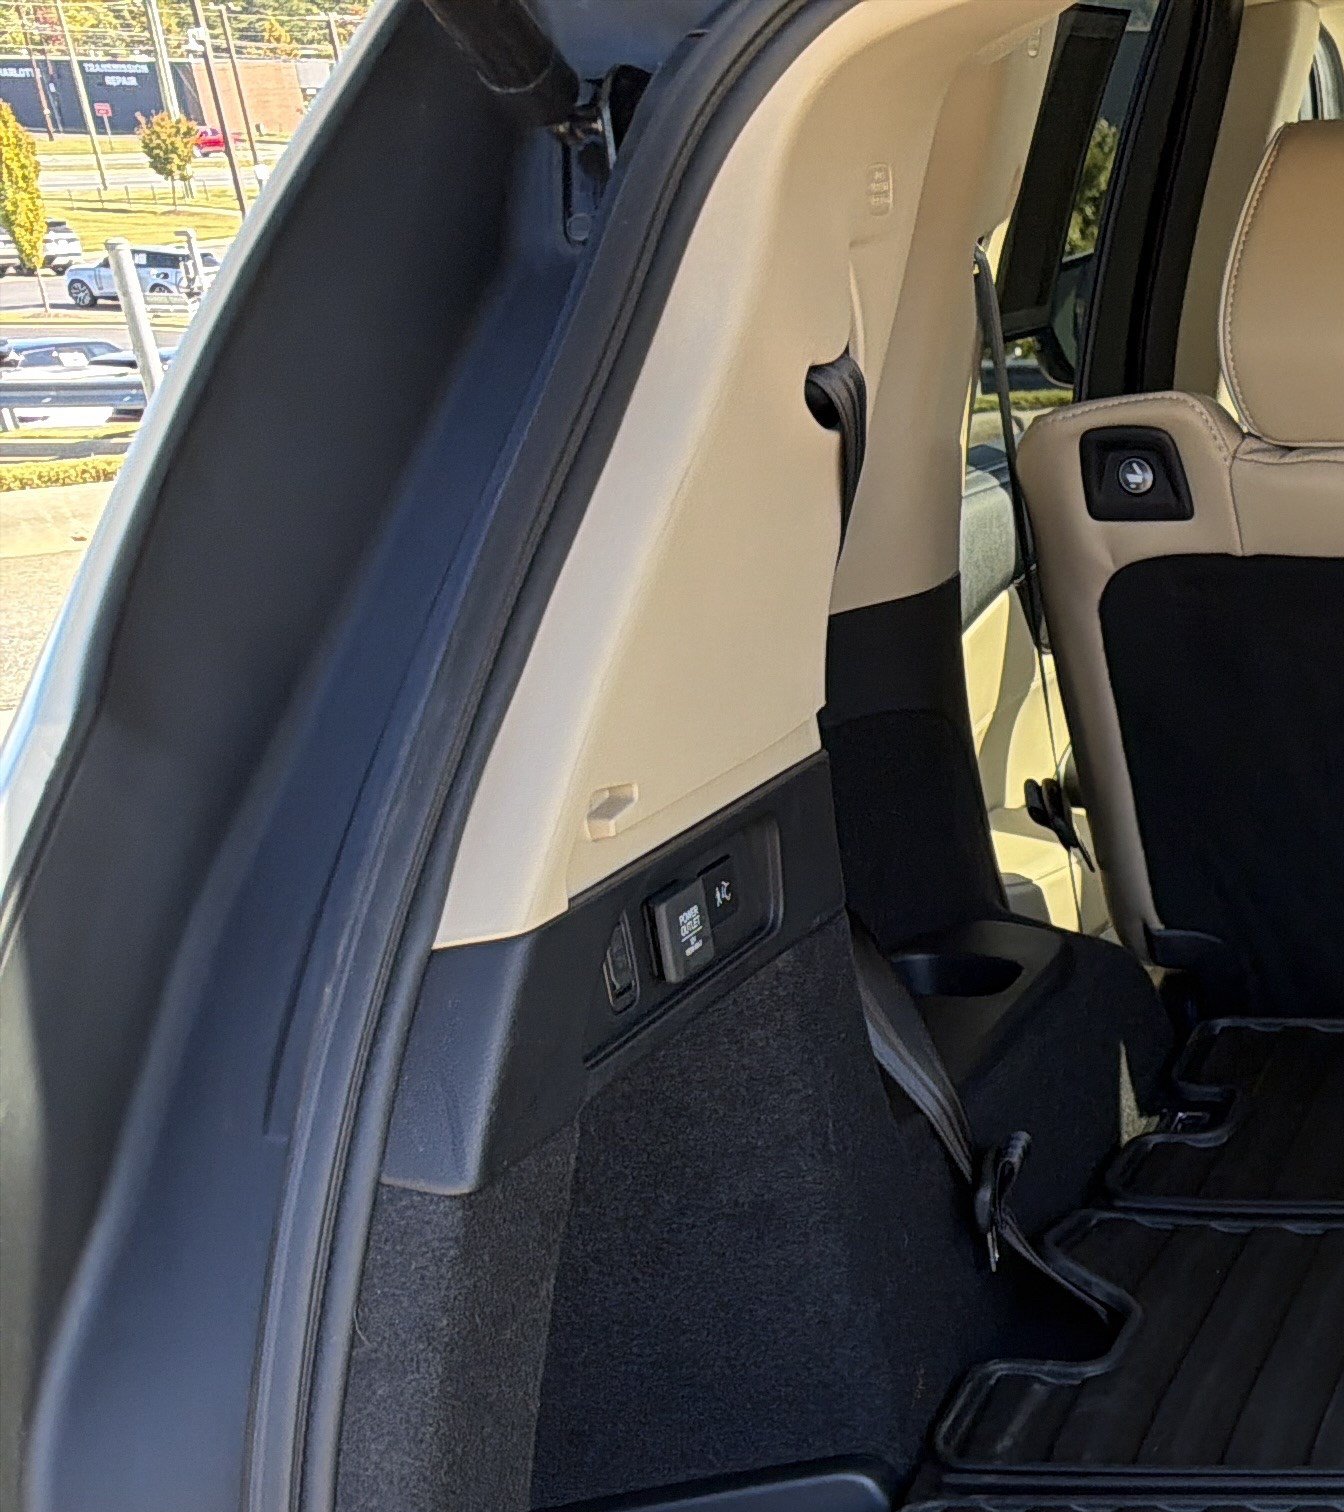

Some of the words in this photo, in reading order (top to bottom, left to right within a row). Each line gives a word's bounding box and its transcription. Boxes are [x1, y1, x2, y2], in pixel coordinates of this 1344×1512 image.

[104, 76, 138, 86] REPAIR
[679, 904, 699, 926] POWER
[681, 915, 701, 937] OUTLET
